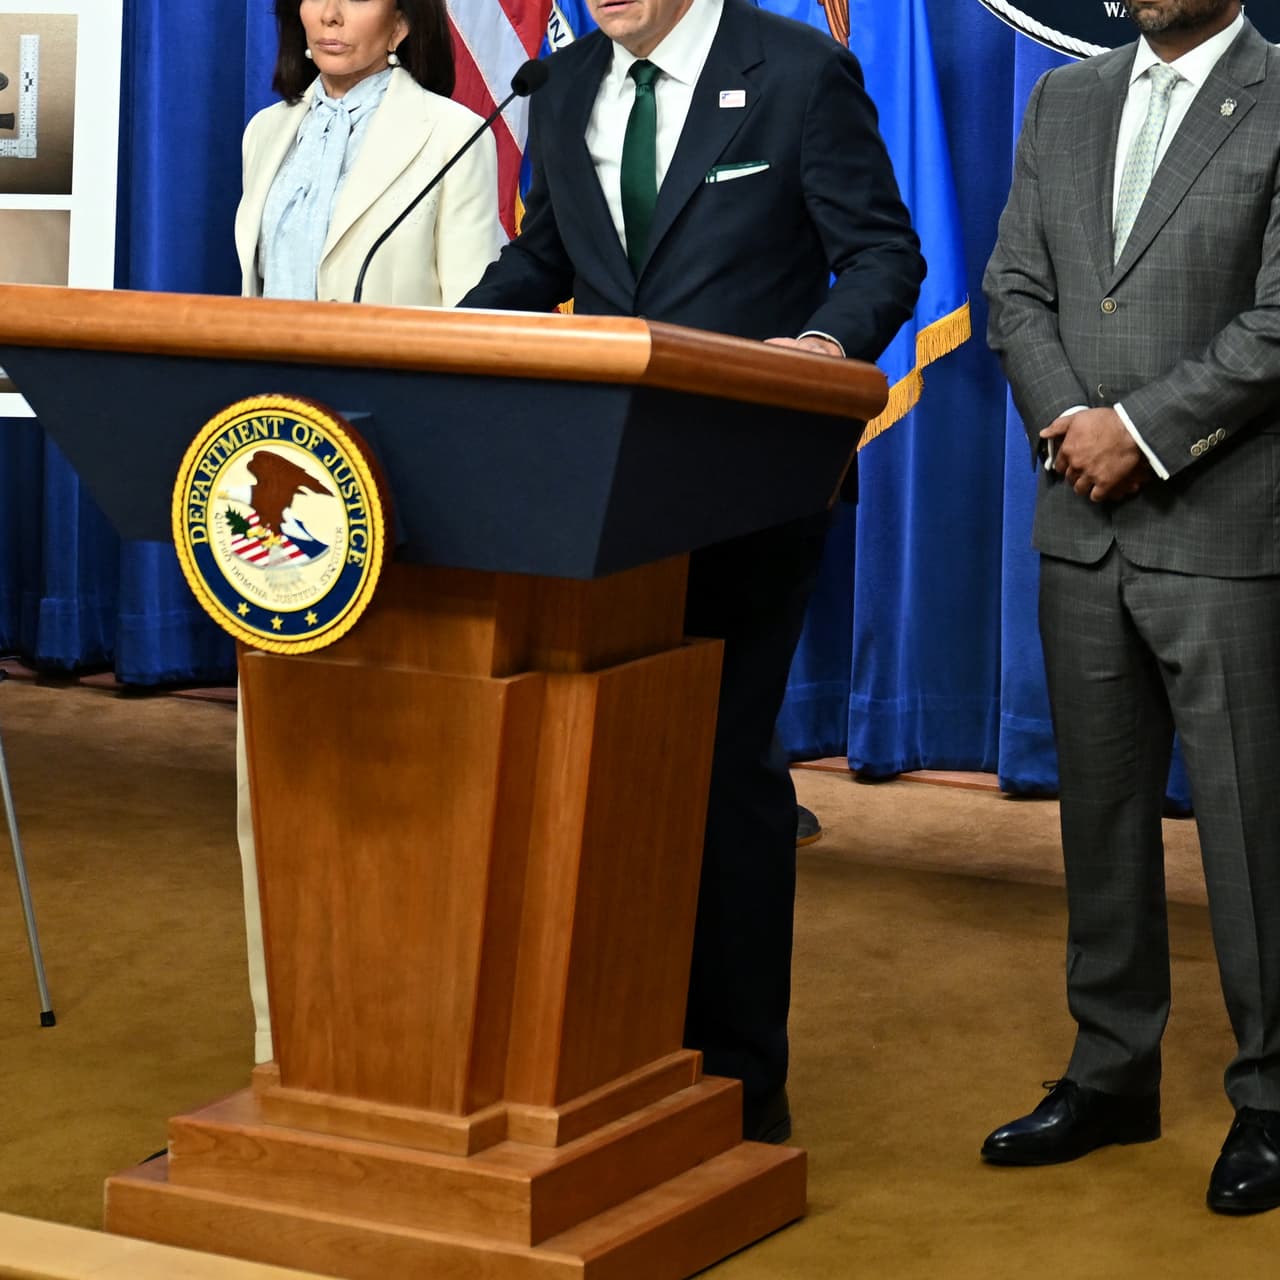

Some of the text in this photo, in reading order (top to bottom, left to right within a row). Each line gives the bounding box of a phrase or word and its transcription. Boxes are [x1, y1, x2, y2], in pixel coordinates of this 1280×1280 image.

[190, 417, 369, 568] DEPARTMENT OF JUSTICE
